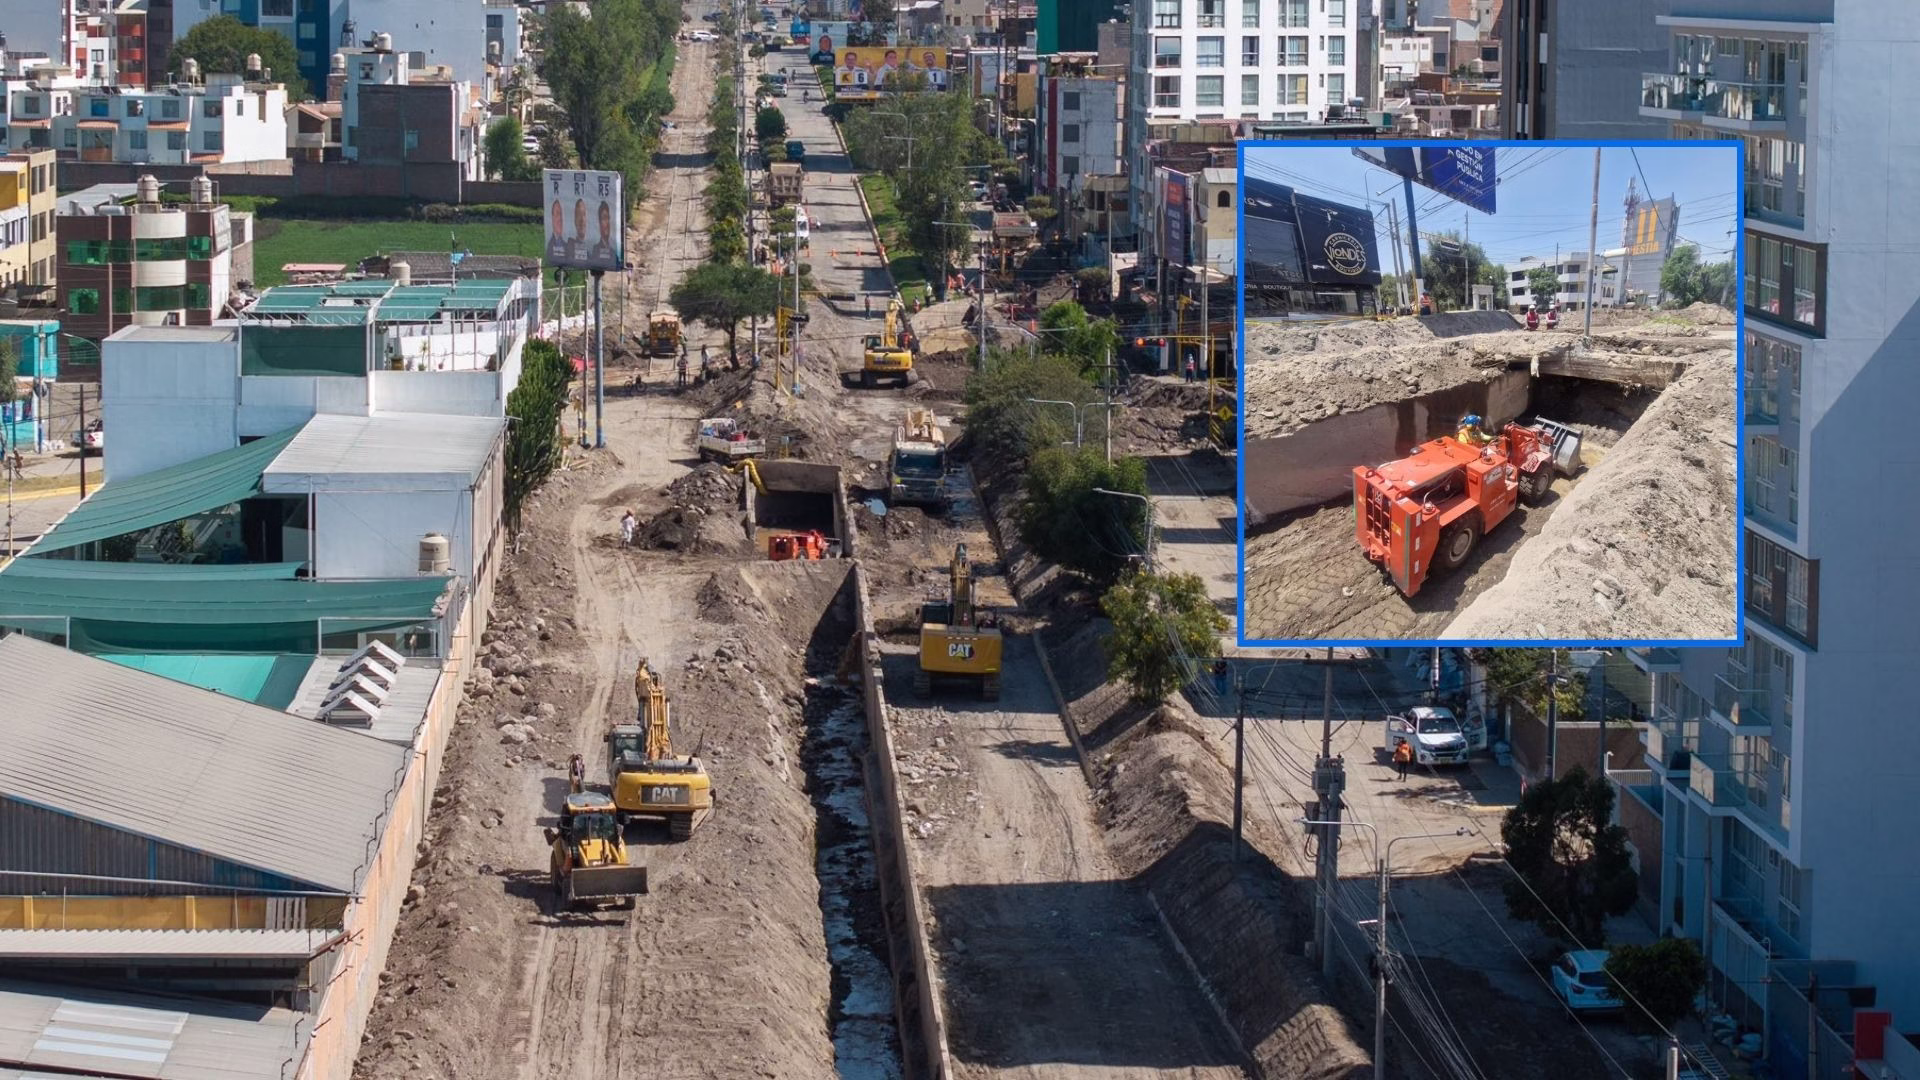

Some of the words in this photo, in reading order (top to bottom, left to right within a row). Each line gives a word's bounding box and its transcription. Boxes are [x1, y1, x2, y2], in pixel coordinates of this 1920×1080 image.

[858, 73, 865, 83] 6
[553, 181, 559, 195] R
[574, 182, 585, 195] R1
[948, 643, 971, 657] CAT
[652, 787, 678, 803] CAT
